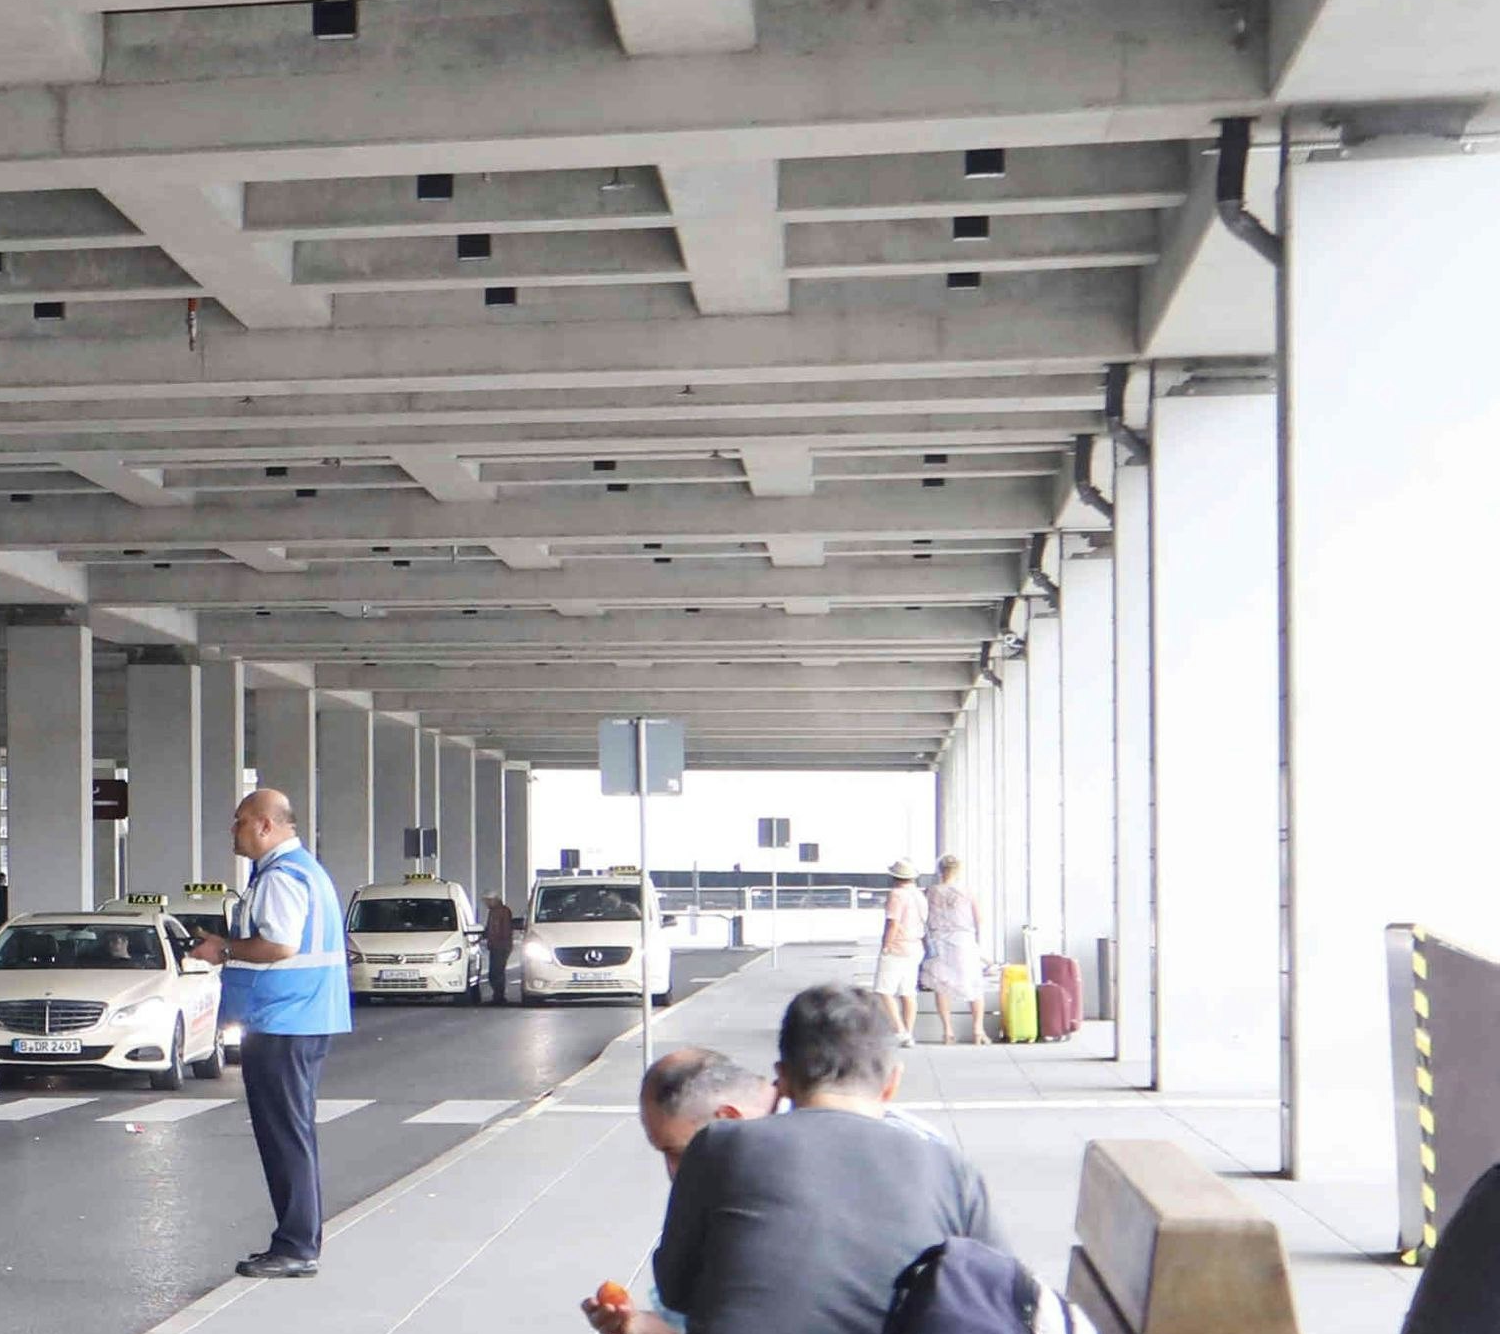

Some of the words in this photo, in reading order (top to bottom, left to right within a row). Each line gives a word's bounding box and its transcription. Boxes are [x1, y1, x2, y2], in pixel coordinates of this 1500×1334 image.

[132, 895, 158, 904] TAXI
[35, 1042, 49, 1051] DR
[51, 1042, 79, 1052] 2491
